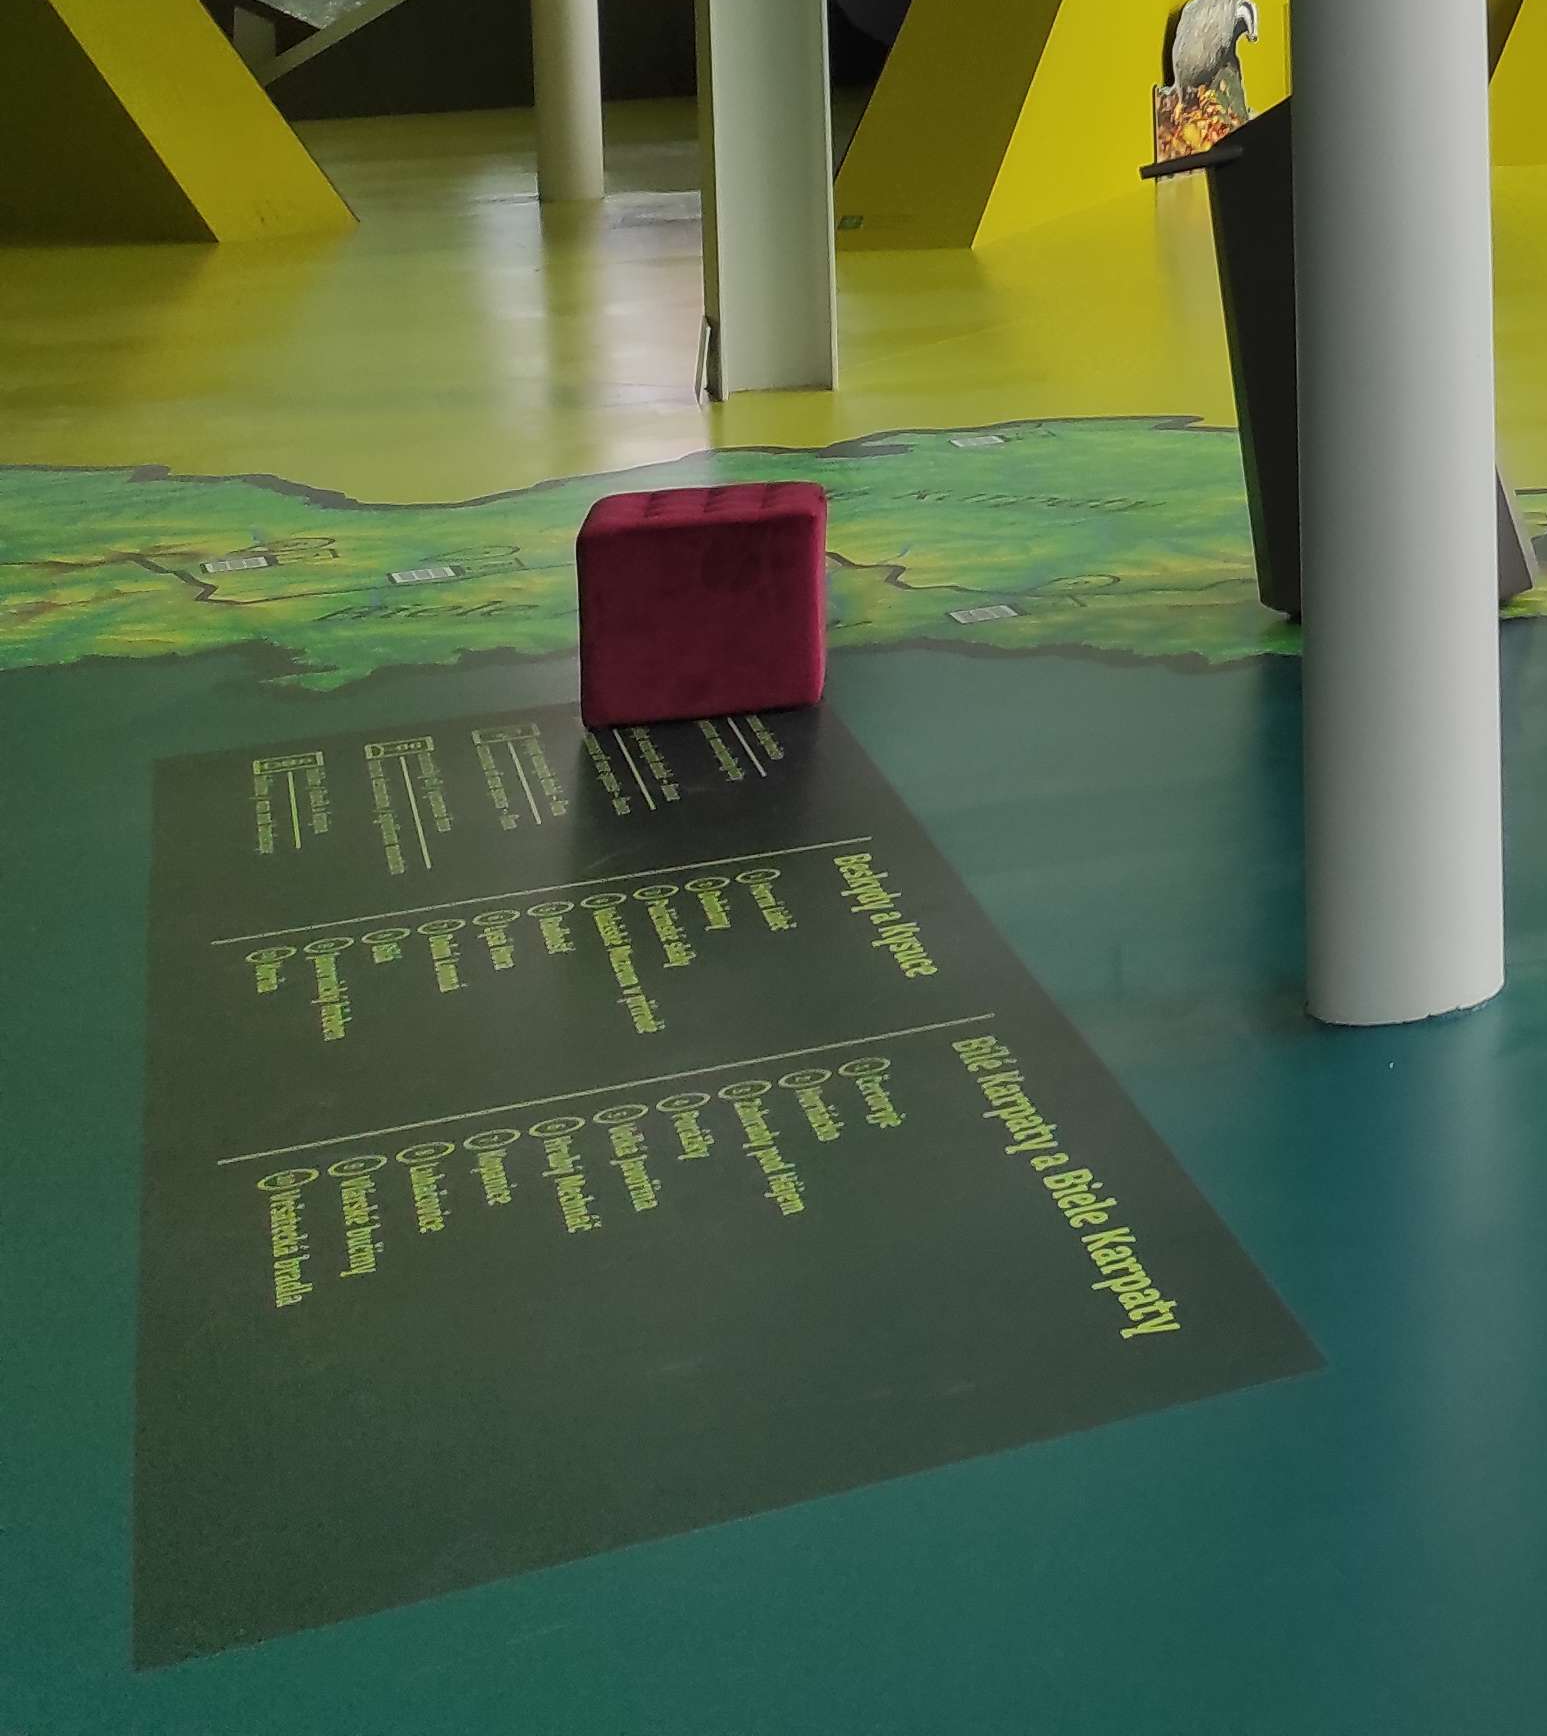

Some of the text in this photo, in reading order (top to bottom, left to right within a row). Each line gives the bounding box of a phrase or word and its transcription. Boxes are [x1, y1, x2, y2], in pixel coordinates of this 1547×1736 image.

[833, 853, 938, 978] Beskydy a Kysuce
[733, 1097, 780, 1149] Zahrady
[470, 1148, 518, 1206] Kopanice
[746, 1145, 796, 1174] pod
[951, 1035, 1181, 1339] Bílé Karpaty a Biele Karpaty
[409, 1161, 451, 1234] Luhačovice
[763, 1171, 805, 1216] Hájem
[339, 1223, 384, 1278] bučiny
[273, 1254, 313, 1308] bradla
